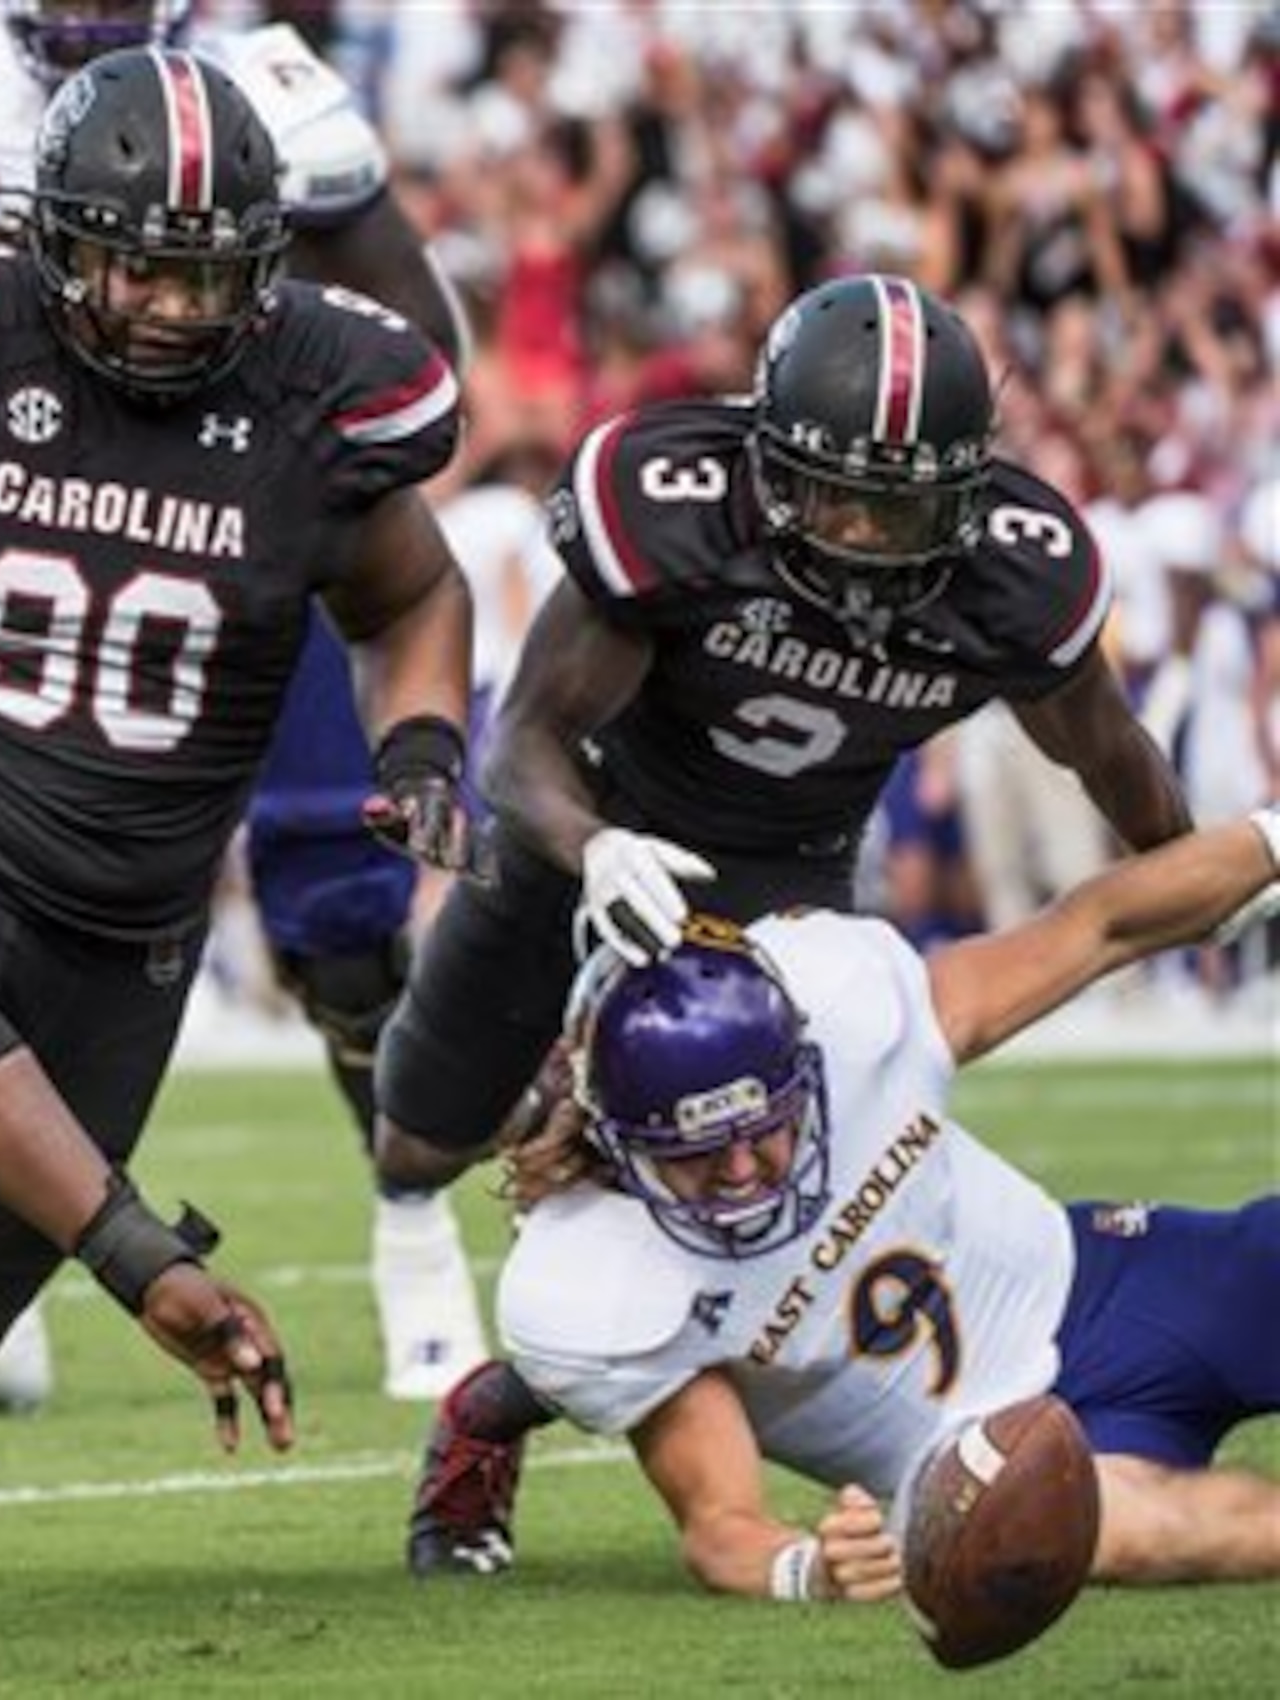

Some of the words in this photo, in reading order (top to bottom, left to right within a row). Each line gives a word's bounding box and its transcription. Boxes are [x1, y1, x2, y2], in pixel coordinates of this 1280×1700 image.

[6, 386, 63, 443] SEC
[640, 456, 728, 503] 3
[987, 504, 1073, 559] 3
[702, 619, 959, 710] CAROLINA
[747, 1273, 817, 1367] EAST
[811, 1111, 942, 1272] CAROLINA
[848, 1245, 962, 1402] 9
